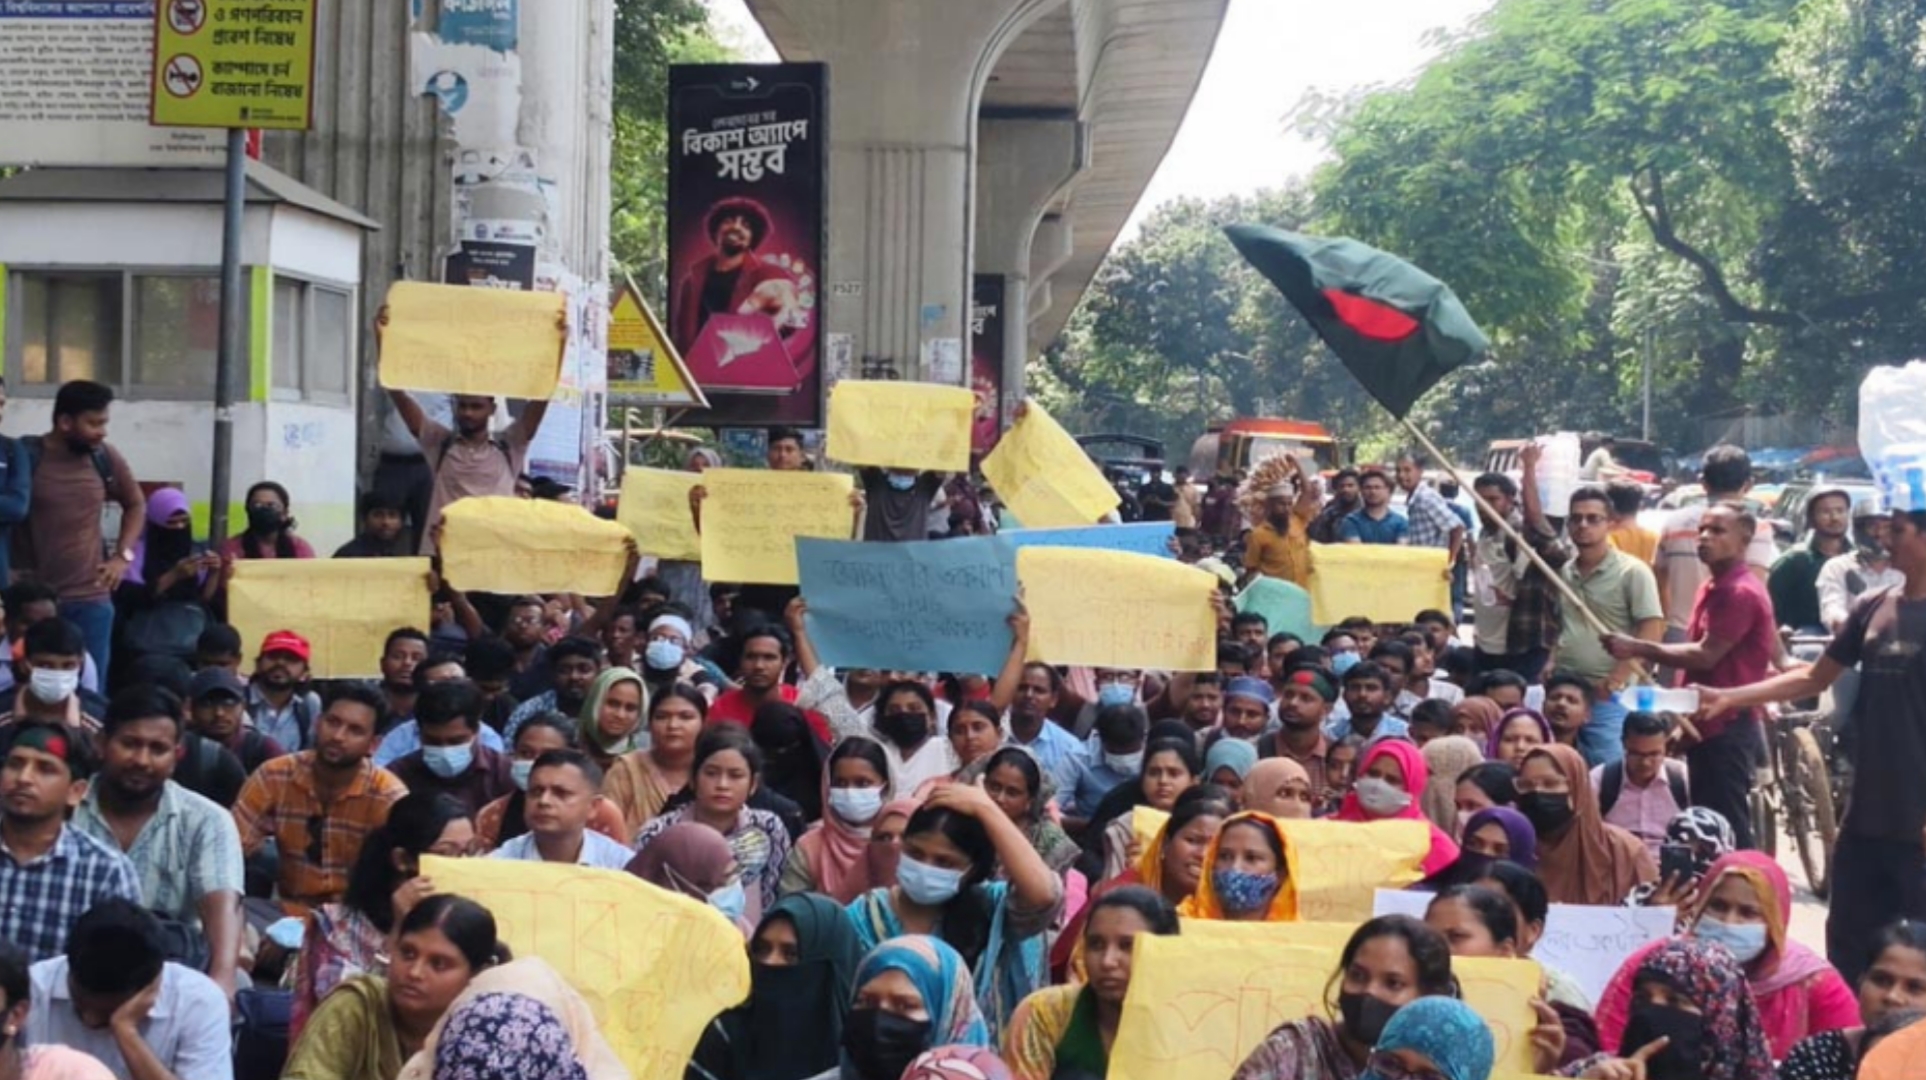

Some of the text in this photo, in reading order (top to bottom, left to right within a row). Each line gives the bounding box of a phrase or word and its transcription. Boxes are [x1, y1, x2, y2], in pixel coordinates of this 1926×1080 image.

[214, 4, 303, 23] ও গণপরিবহন
[212, 26, 295, 46] প্রবেশ নিষেধ
[212, 60, 268, 76] ক্যাম্পাসে
[210, 79, 303, 98] বাজানো নিষেধ
[682, 119, 808, 156] বিকাশ অ্যাপে
[715, 143, 788, 182] সম্ভব
